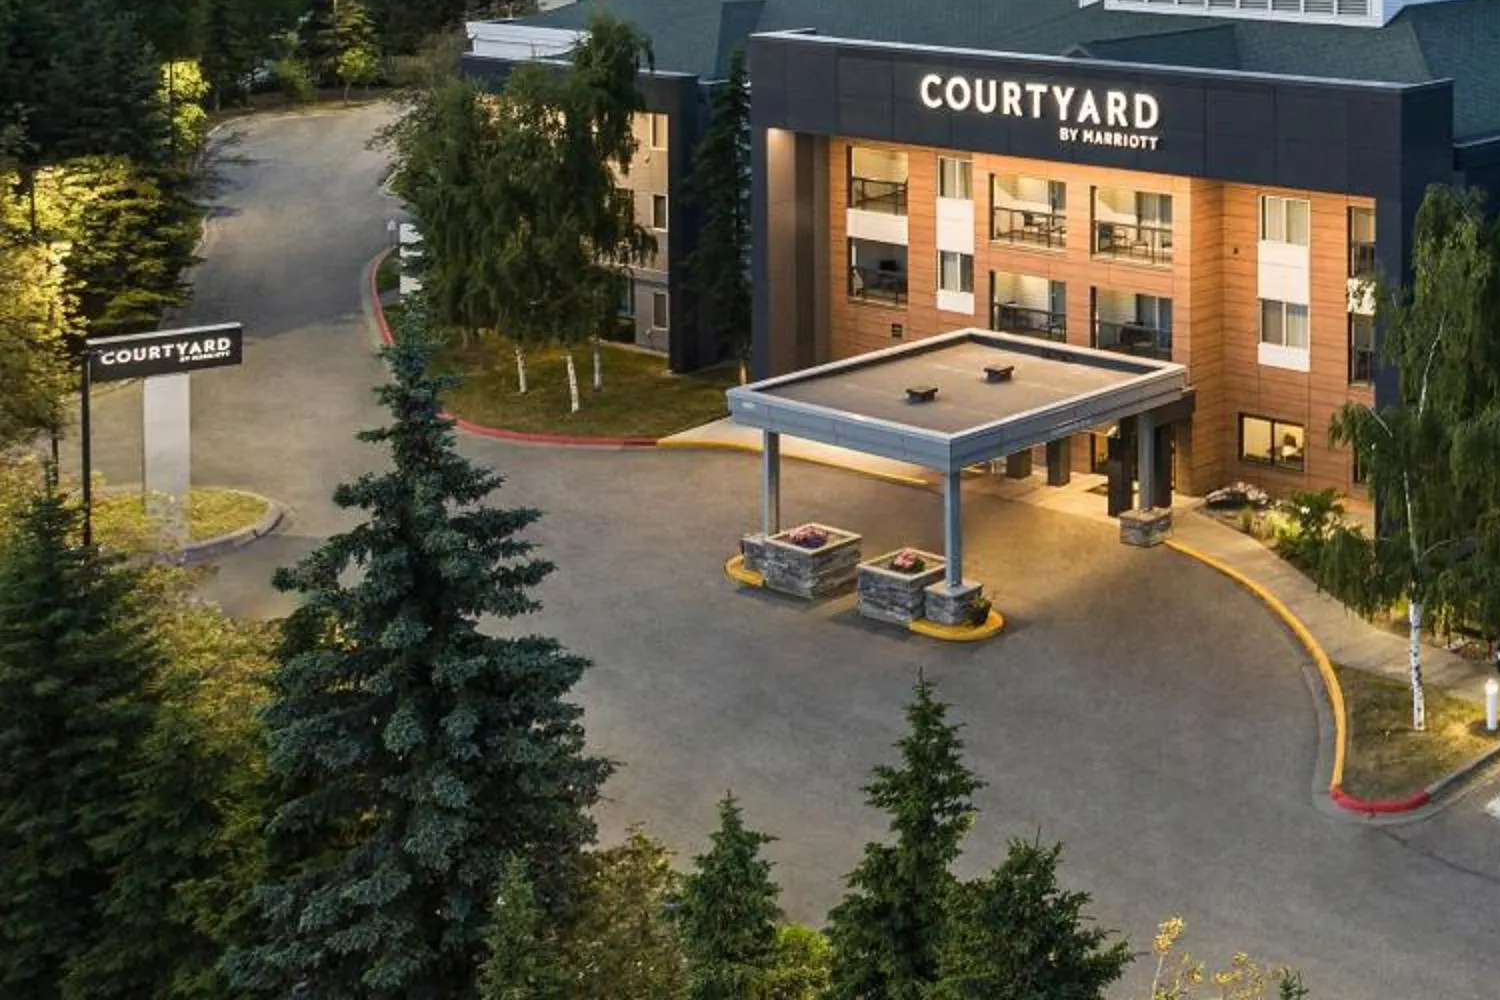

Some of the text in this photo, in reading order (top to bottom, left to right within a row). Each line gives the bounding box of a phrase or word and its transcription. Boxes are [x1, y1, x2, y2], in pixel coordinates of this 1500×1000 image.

[920, 73, 1159, 129] COURTYARD
[1059, 127, 1159, 151] BY MARRIOTT
[101, 337, 231, 365] COURTYARD
